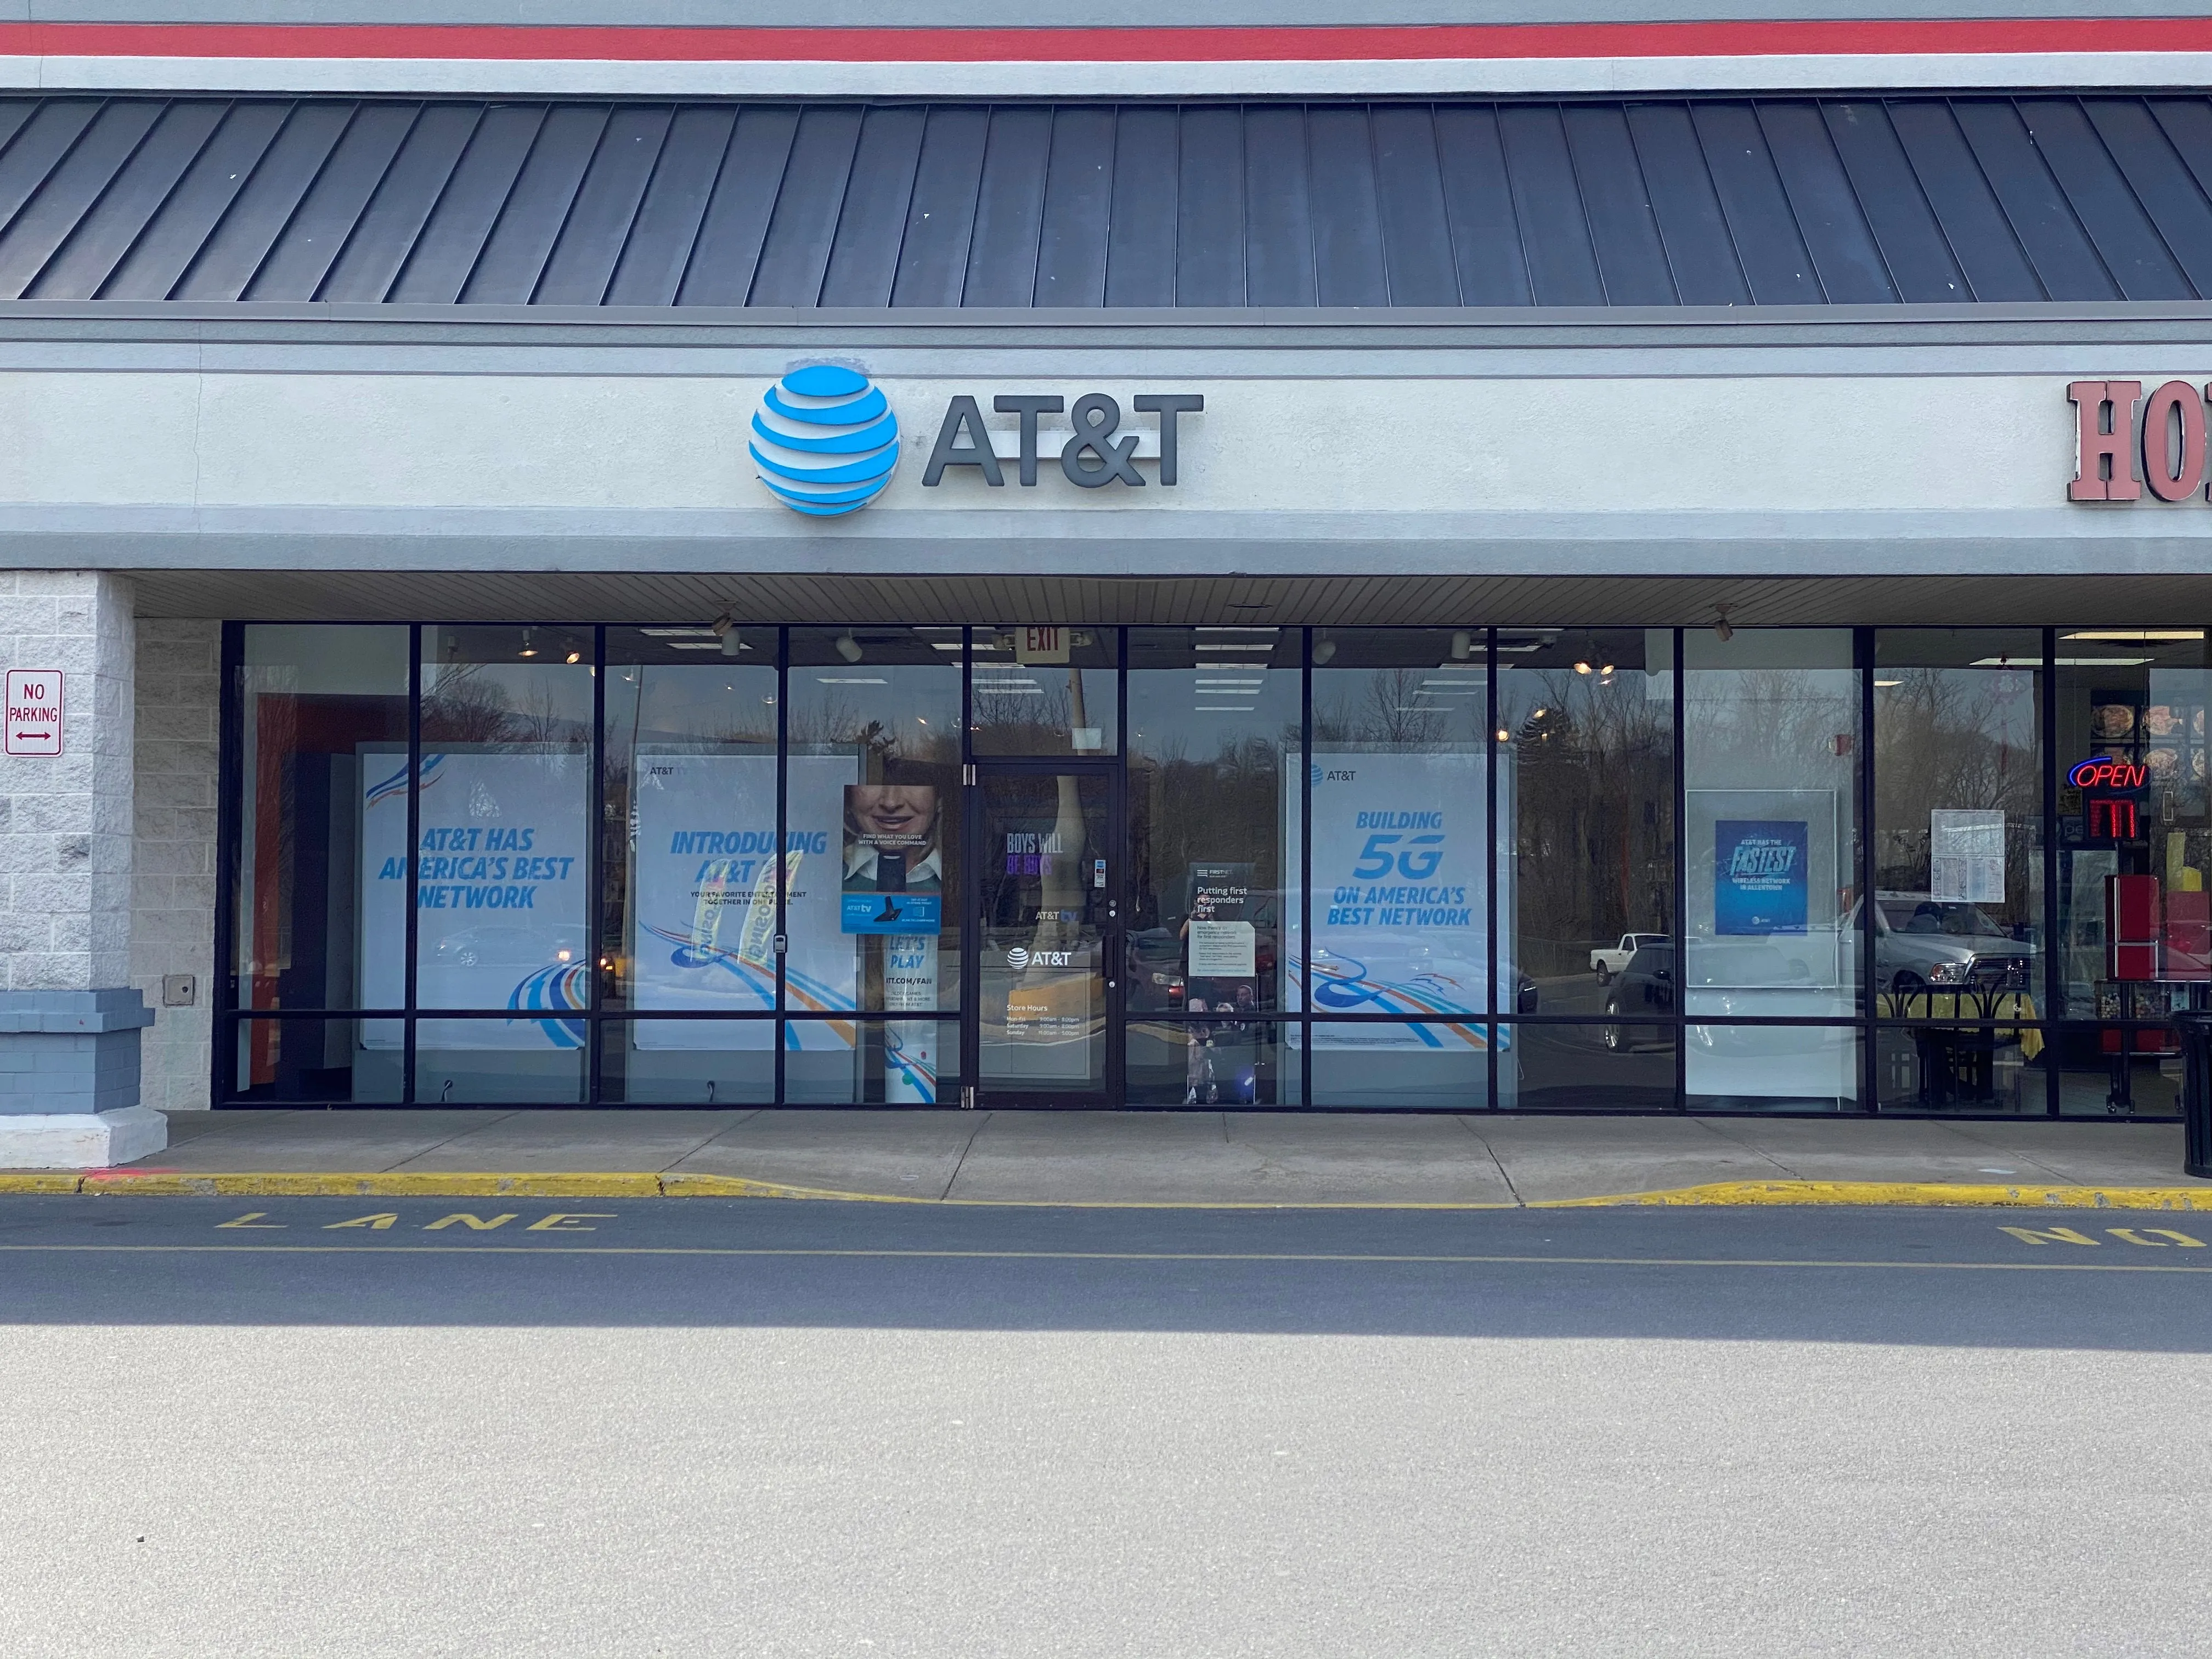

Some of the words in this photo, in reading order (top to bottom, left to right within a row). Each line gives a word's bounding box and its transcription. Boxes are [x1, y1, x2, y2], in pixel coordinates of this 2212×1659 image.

[921, 393, 1204, 488] AT&T
[2066, 380, 2212, 503] HO
[1026, 627, 1060, 652] EXIT
[24, 684, 44, 699] NO
[9, 707, 58, 722] PARKING
[1327, 771, 1356, 781] AT&T
[2076, 765, 2145, 786] OPEN
[1356, 811, 1442, 830] BUILDING
[419, 828, 482, 851] AT&T
[485, 828, 534, 851] HAS
[1007, 833, 1035, 853] BOYS
[1038, 833, 1063, 853] WILL
[1352, 834, 1446, 880] 5G
[1729, 847, 1796, 876] FASTEST
[512, 856, 575, 880] BEST
[695, 860, 756, 883] A&T
[418, 885, 538, 909] NETWORK
[1197, 887, 1227, 895] Putting
[1197, 896, 1244, 905] responders
[1333, 886, 1361, 904] ON
[1364, 886, 1465, 905] AMERICA'S
[1035, 911, 1059, 920] AT&T
[1327, 907, 1374, 926] BEST
[1378, 907, 1472, 926] NETWORK
[890, 936, 926, 950] LET'S
[890, 955, 924, 968] PLAY
[1031, 952, 1071, 966] AT&T
[214, 1212, 618, 1231] LANE
[1997, 1226, 2208, 1247] NO
